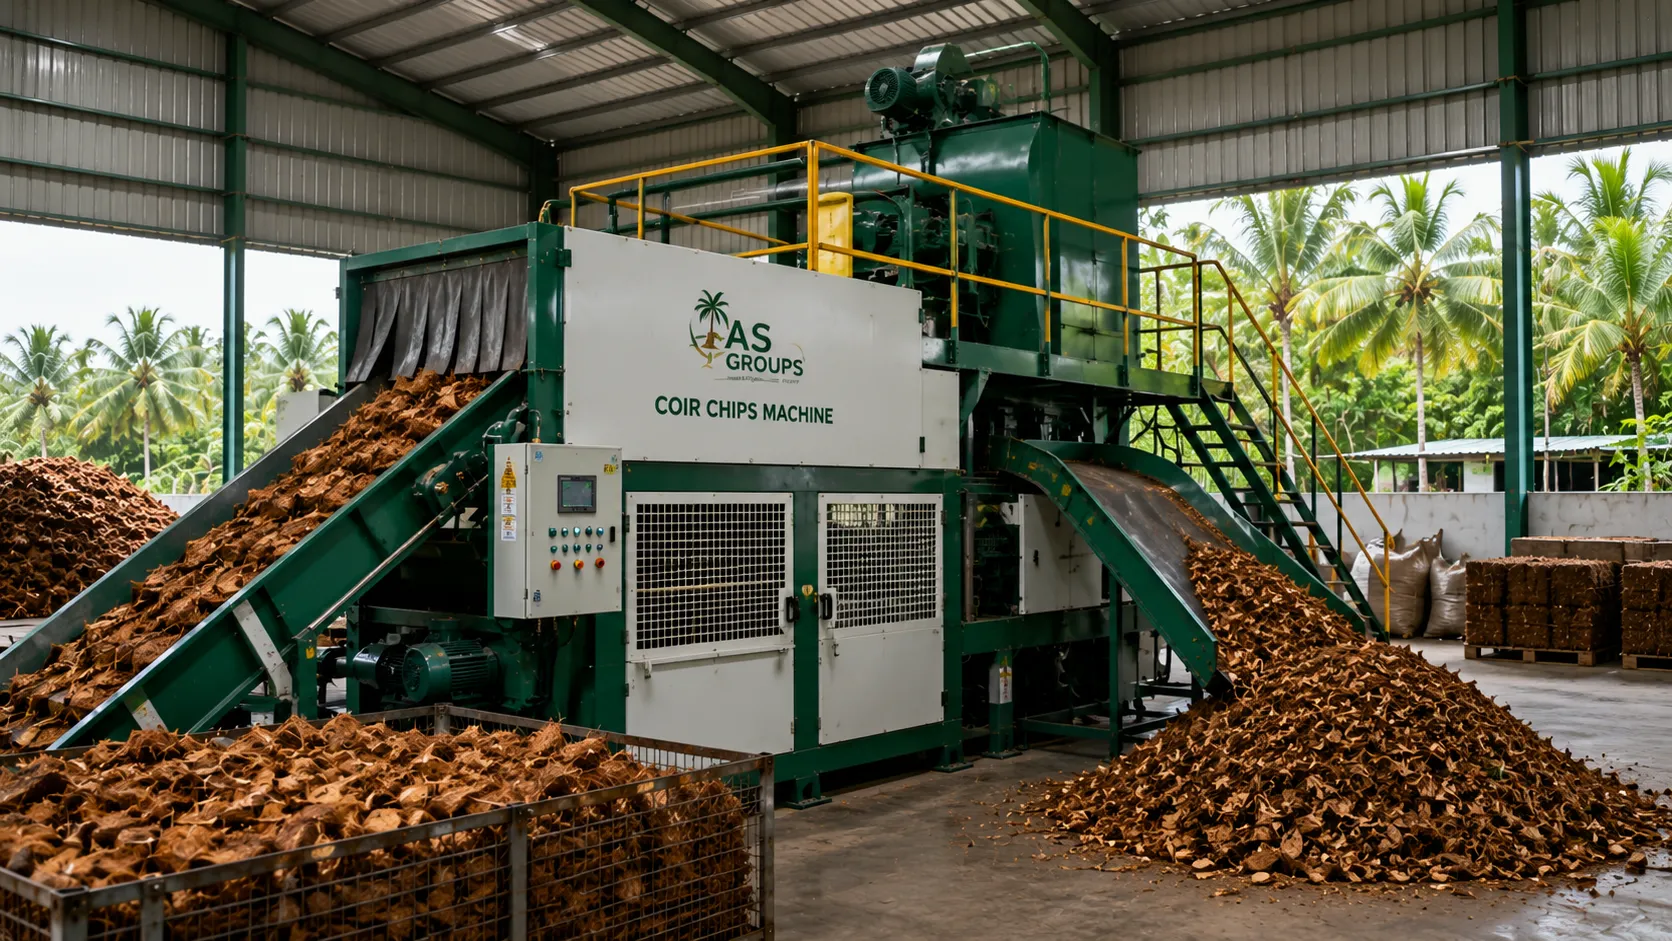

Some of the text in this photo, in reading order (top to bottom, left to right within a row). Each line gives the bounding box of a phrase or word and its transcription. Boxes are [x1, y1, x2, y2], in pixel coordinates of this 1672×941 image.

[725, 320, 772, 353] AS
[726, 353, 803, 376] GROUPS
[655, 395, 834, 424] COIR CHIPS MACHINE
